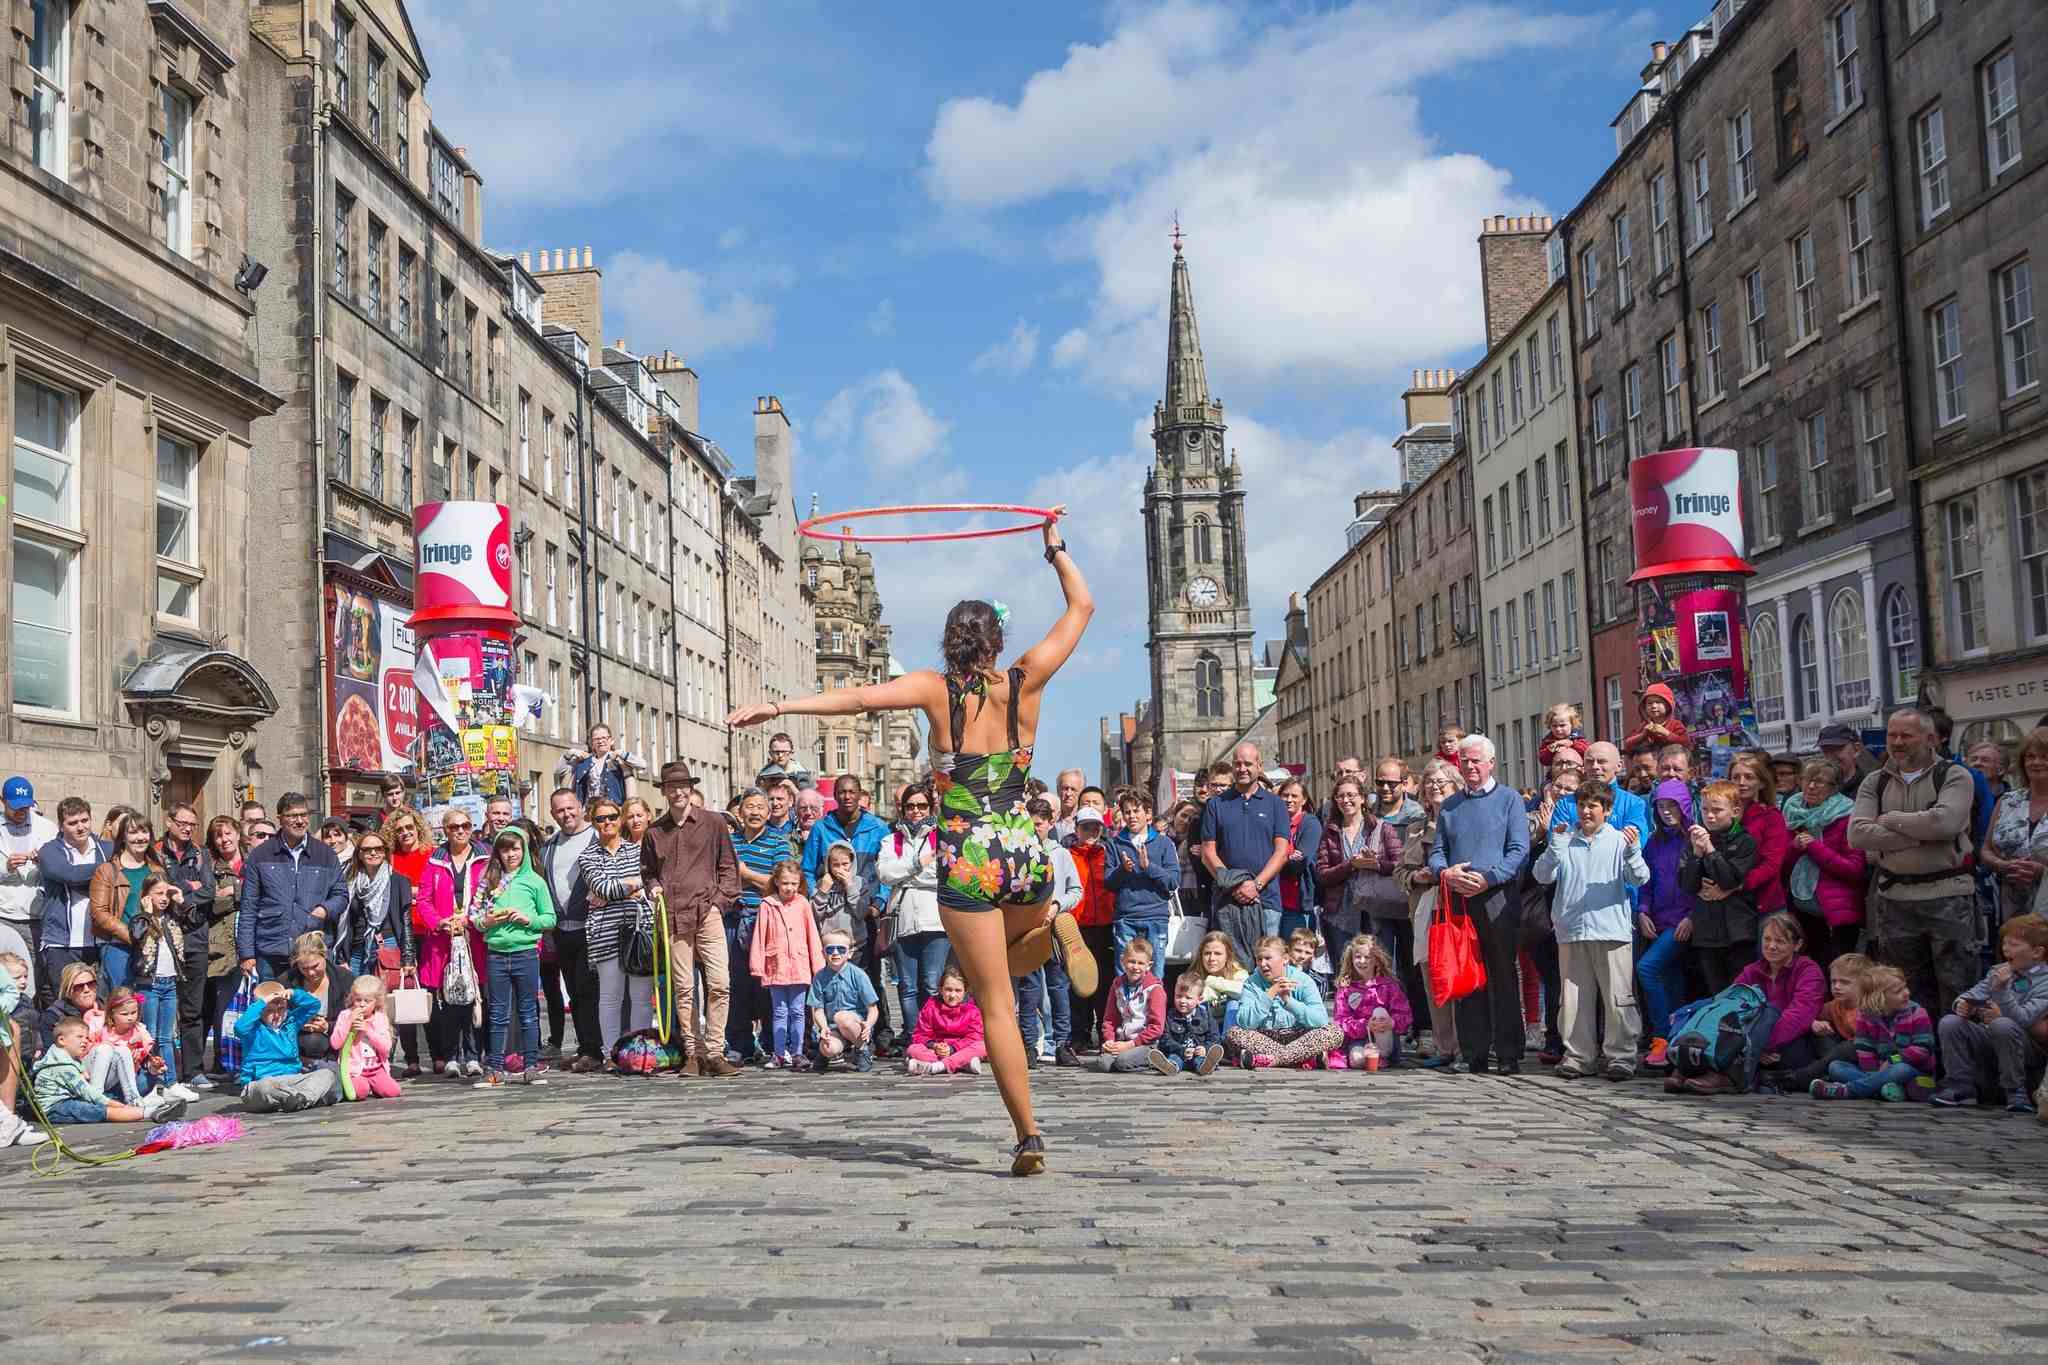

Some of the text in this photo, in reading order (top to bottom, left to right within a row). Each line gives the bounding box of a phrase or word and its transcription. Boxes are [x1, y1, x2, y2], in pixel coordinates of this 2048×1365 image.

[1675, 493, 1730, 516] fringe
[423, 544, 473, 564] fringe
[389, 682, 397, 711] 2
[1967, 685, 2013, 703] TASTE
[2016, 680, 2037, 697] OF
